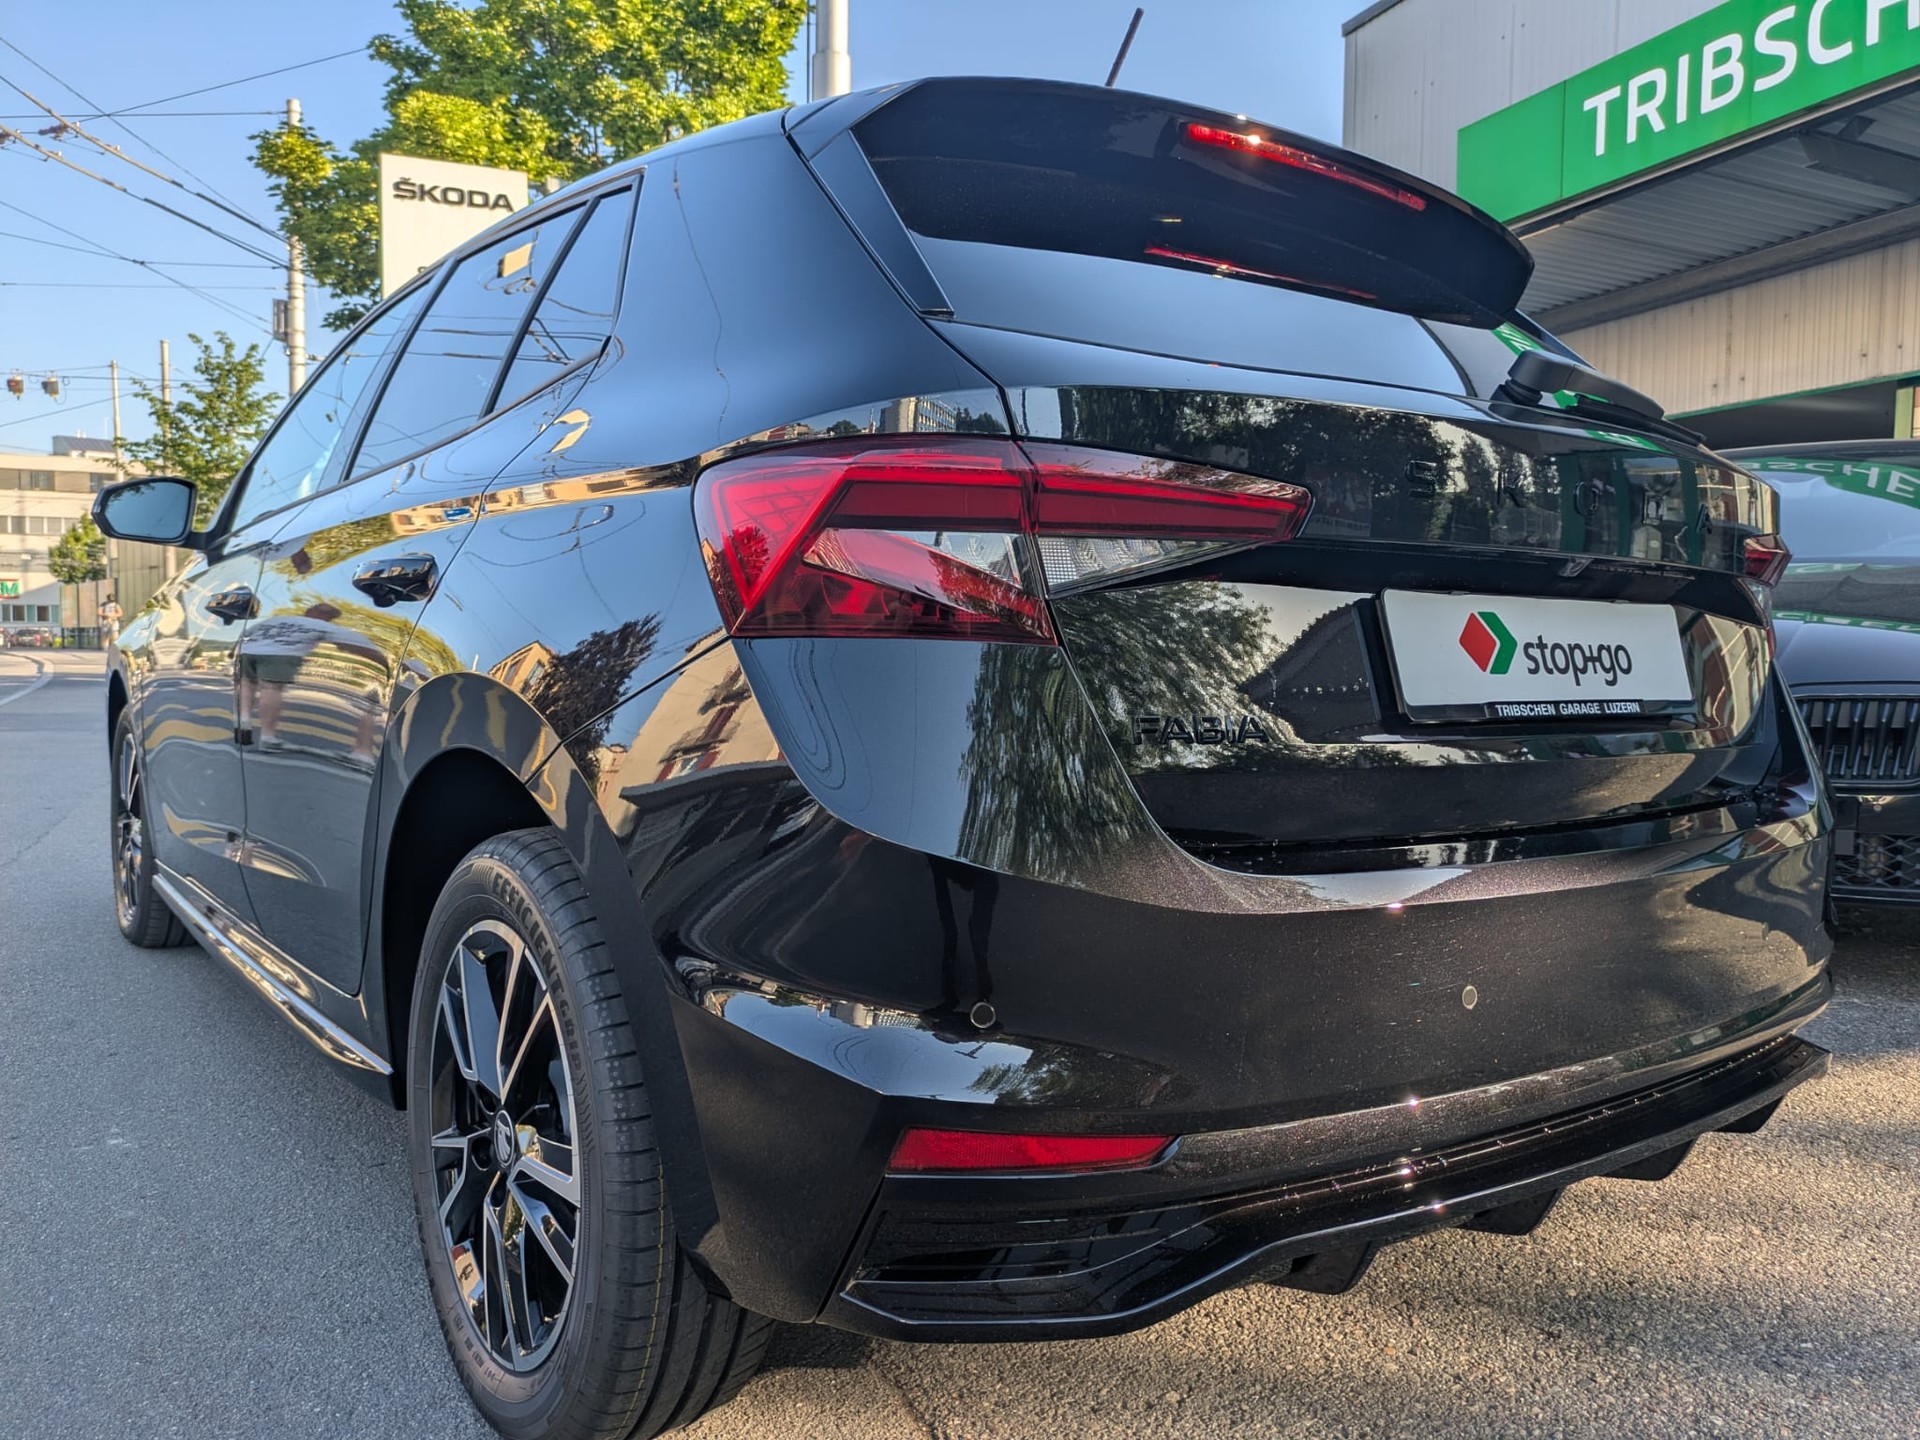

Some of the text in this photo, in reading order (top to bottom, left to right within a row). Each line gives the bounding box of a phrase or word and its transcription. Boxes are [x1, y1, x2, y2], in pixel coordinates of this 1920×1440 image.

[392, 177, 515, 213] ŠKODA
[1523, 635, 1633, 686] stop+go
[1495, 701, 1641, 717] TRIBSCHEN GARAGE LUZERN
[1132, 715, 1270, 745] FABIA
